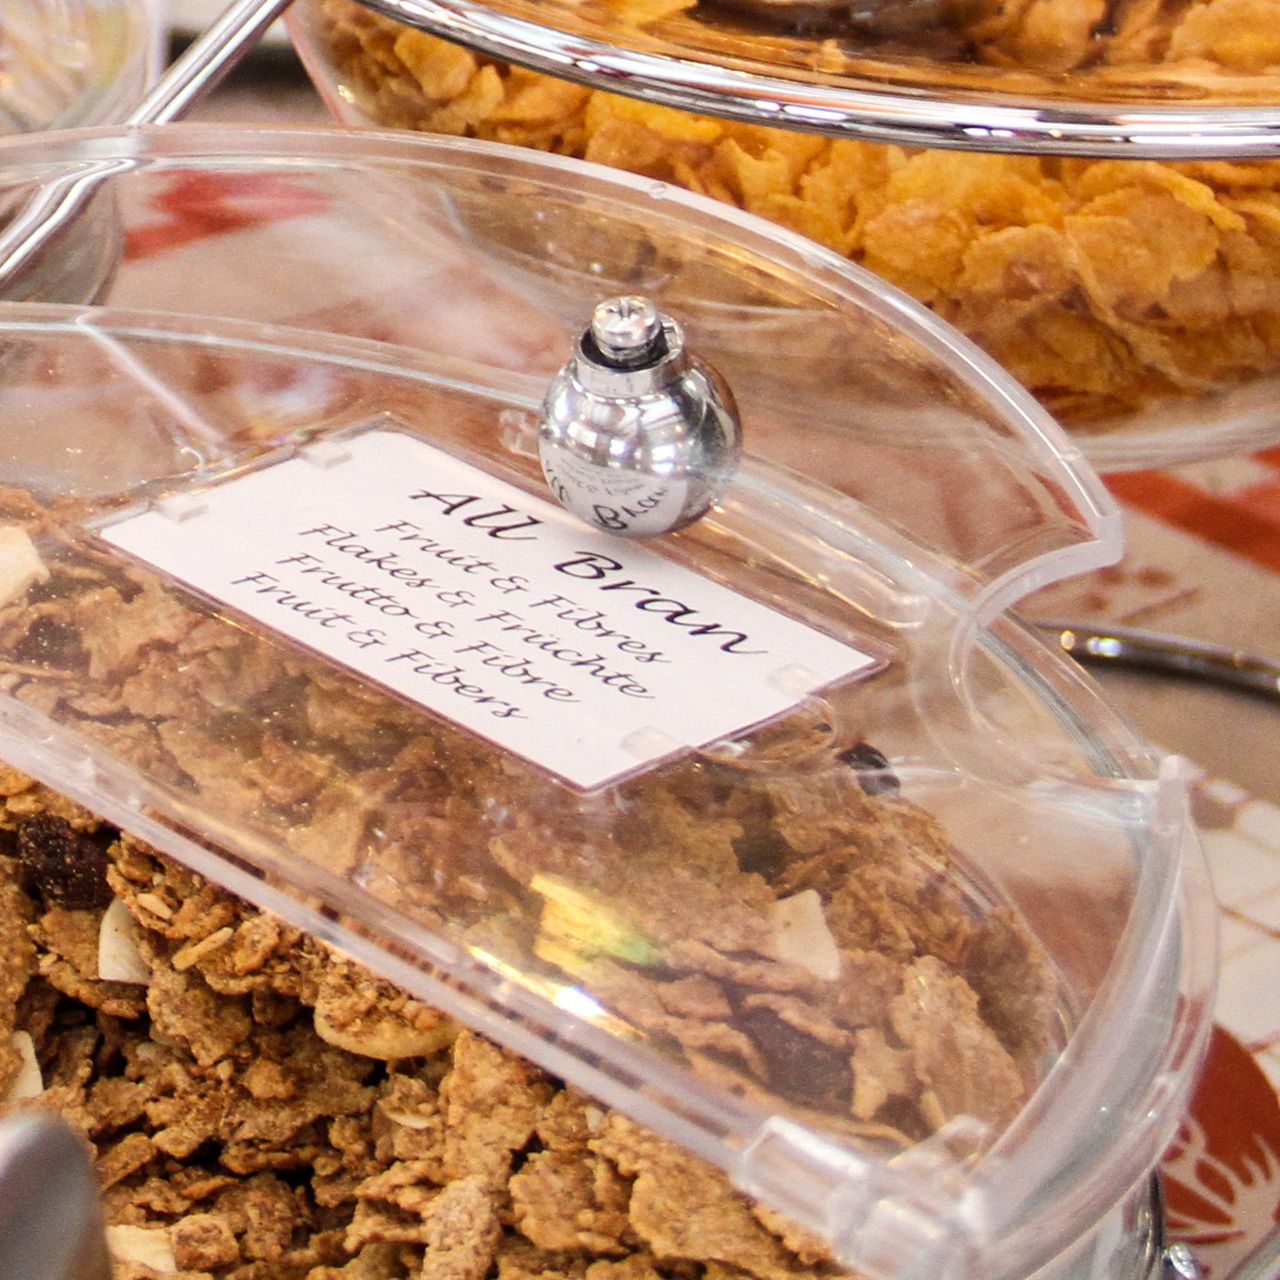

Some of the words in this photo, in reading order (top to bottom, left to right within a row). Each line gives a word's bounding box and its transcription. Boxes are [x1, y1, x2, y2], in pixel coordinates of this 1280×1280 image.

[230, 570, 358, 628] Fruit
[346, 628, 387, 649] &
[384, 648, 529, 720] Fibers
[275, 552, 420, 620] Frutto
[414, 620, 455, 639] &
[455, 640, 582, 704] Fibre
[297, 523, 441, 589] Flakes
[435, 590, 475, 608] &
[474, 608, 656, 700] Früchte
[373, 519, 500, 574] Fruit
[490, 575, 531, 595] &
[529, 593, 672, 664] Fibres
[409, 489, 545, 541] All
[553, 550, 769, 655] Bran
